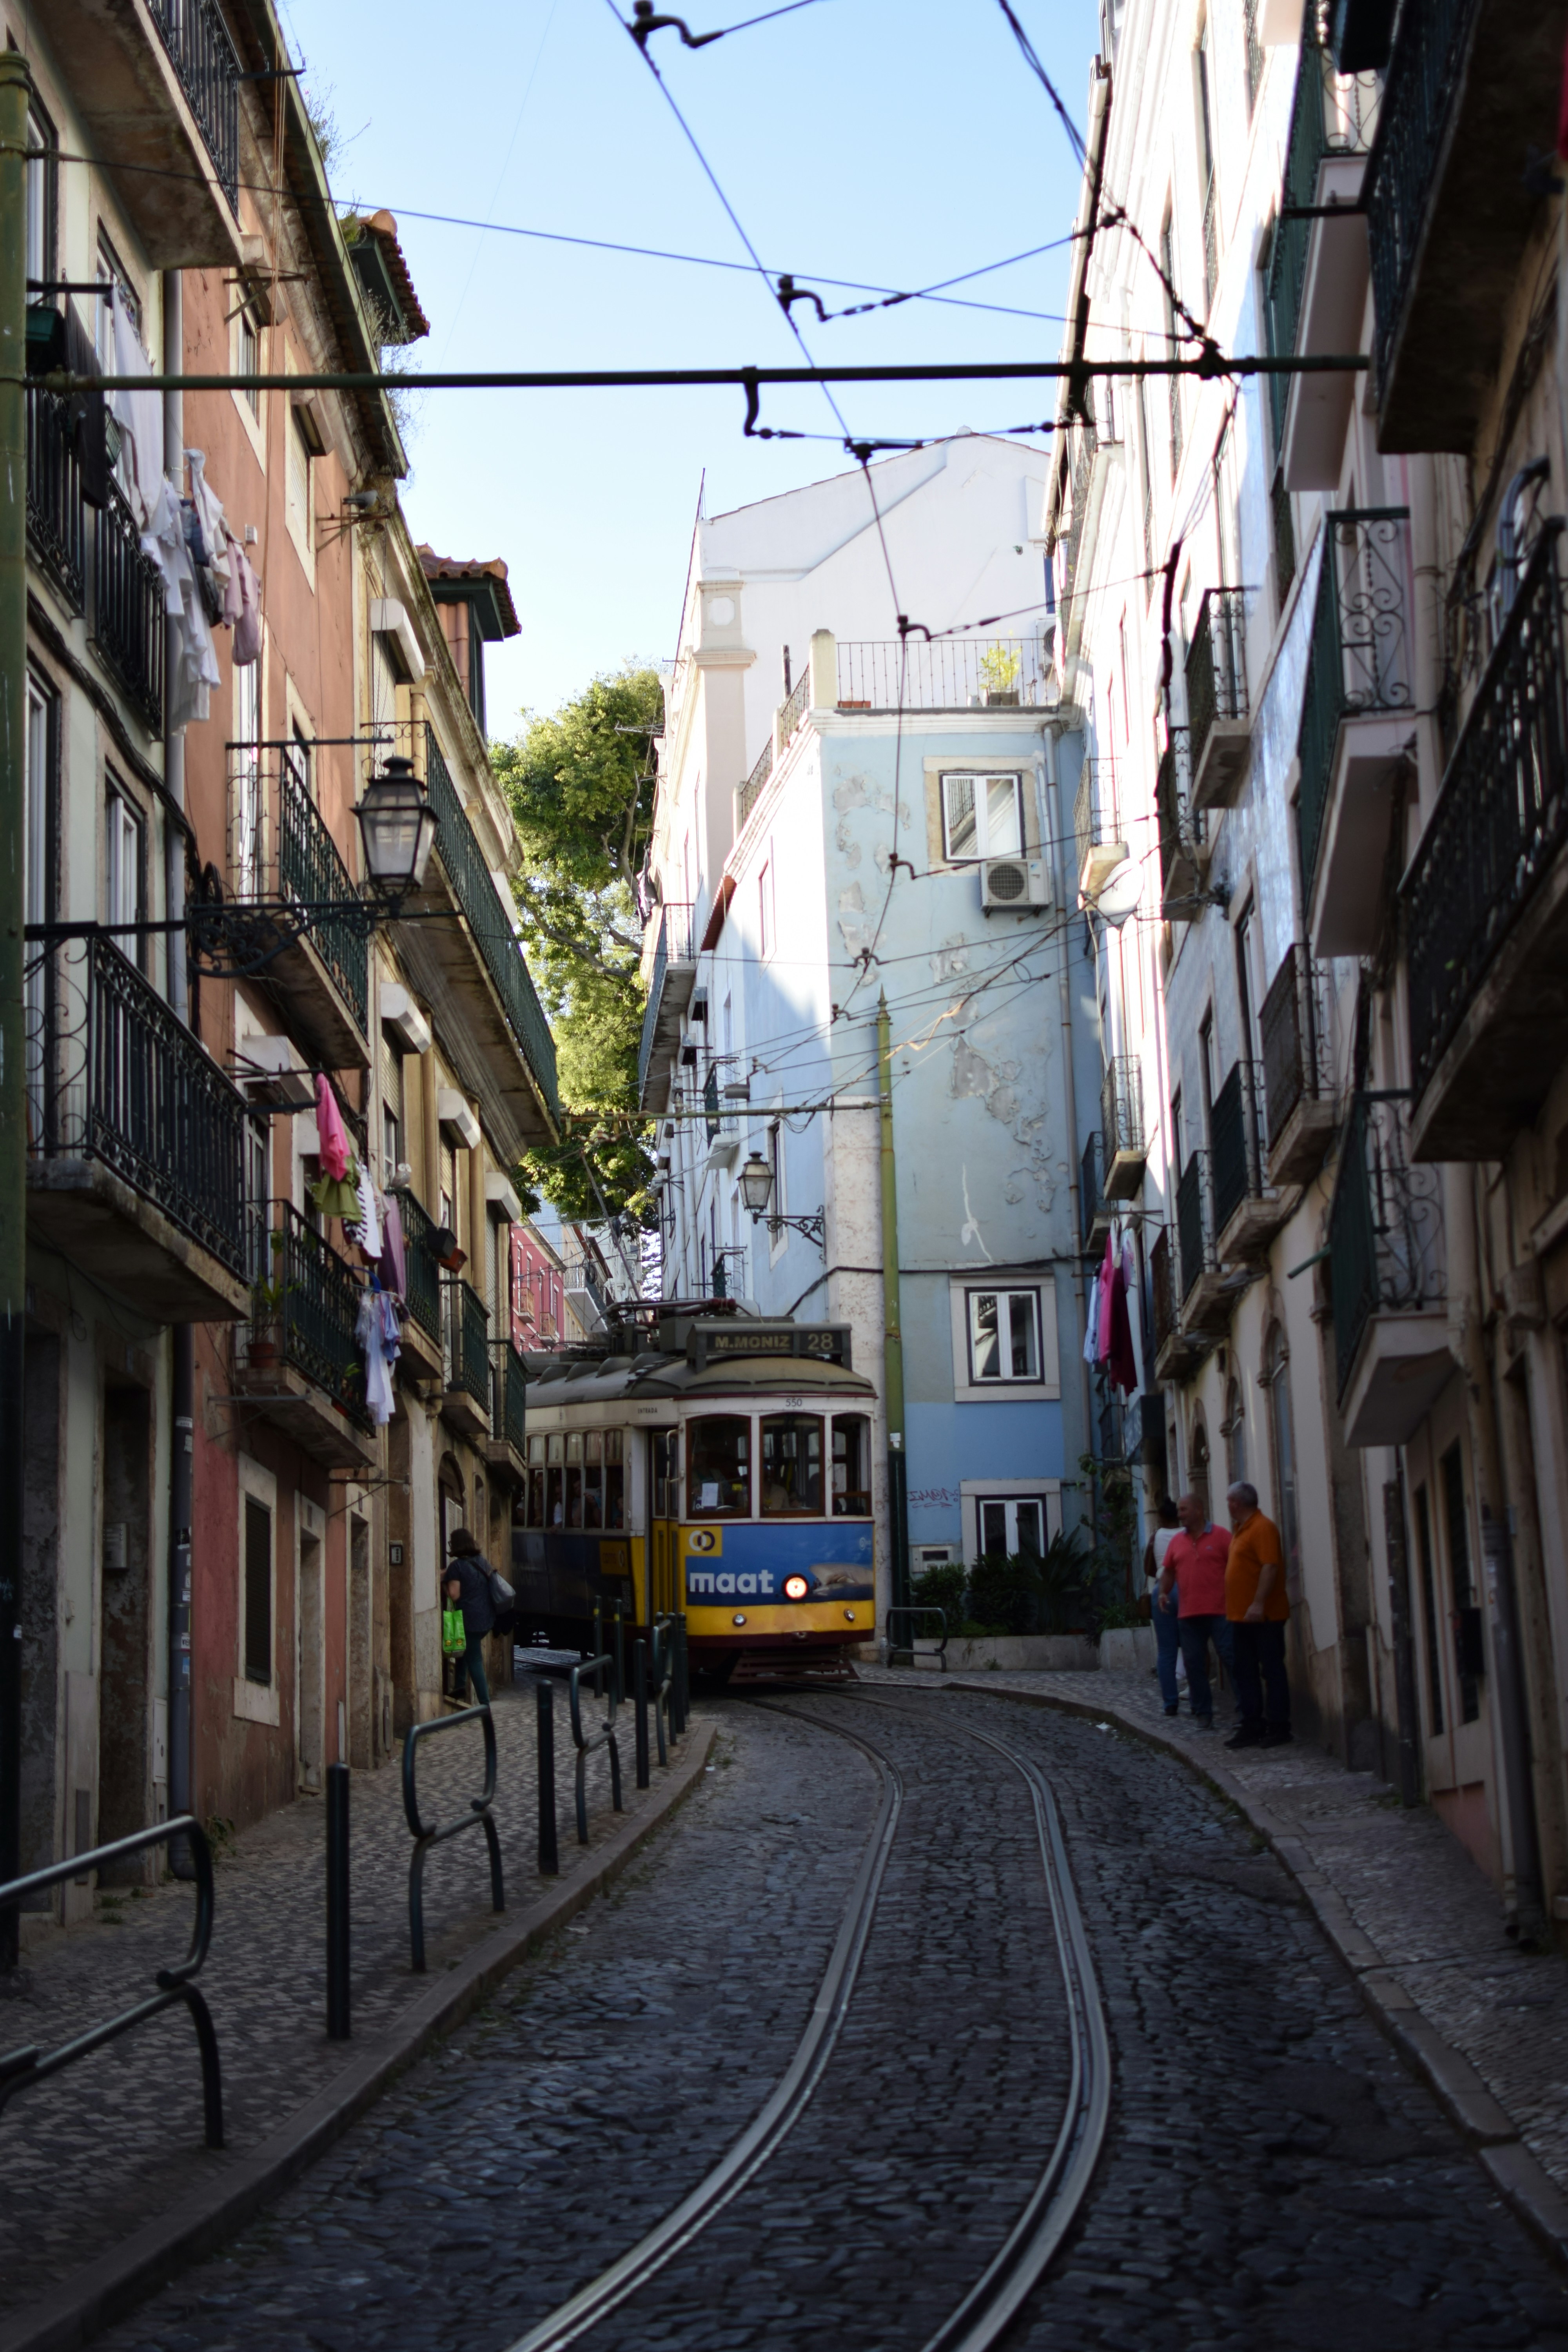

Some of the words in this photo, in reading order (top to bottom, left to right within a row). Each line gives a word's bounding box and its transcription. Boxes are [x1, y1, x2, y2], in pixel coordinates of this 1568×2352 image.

[715, 1335, 790, 1348] M.MONIZ
[808, 1334, 834, 1350] 28
[785, 1398, 802, 1406] 550
[690, 1570, 773, 1593] maat
